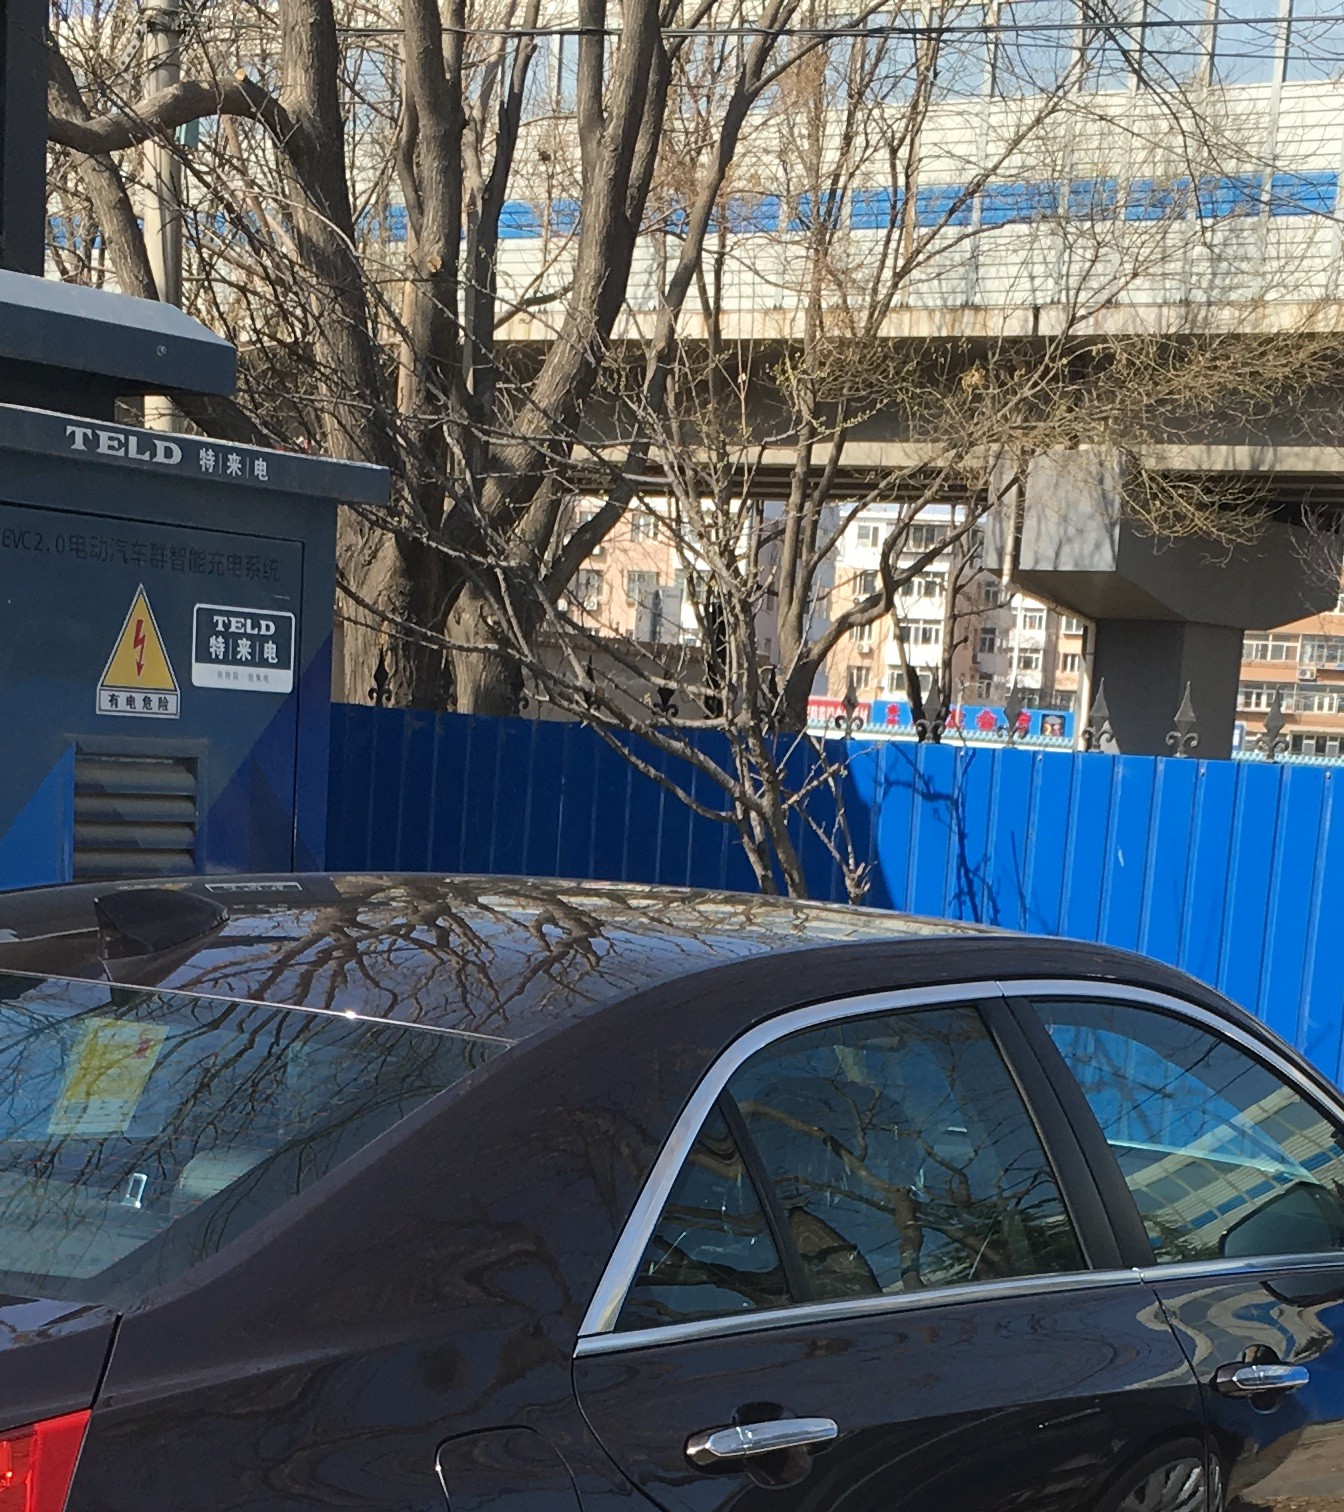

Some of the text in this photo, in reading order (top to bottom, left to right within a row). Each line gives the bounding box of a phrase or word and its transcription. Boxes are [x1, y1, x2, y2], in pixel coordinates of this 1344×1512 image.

[65, 425, 182, 466] TELD
[213, 615, 276, 636] TELD
[108, 693, 170, 712] 有电危险
